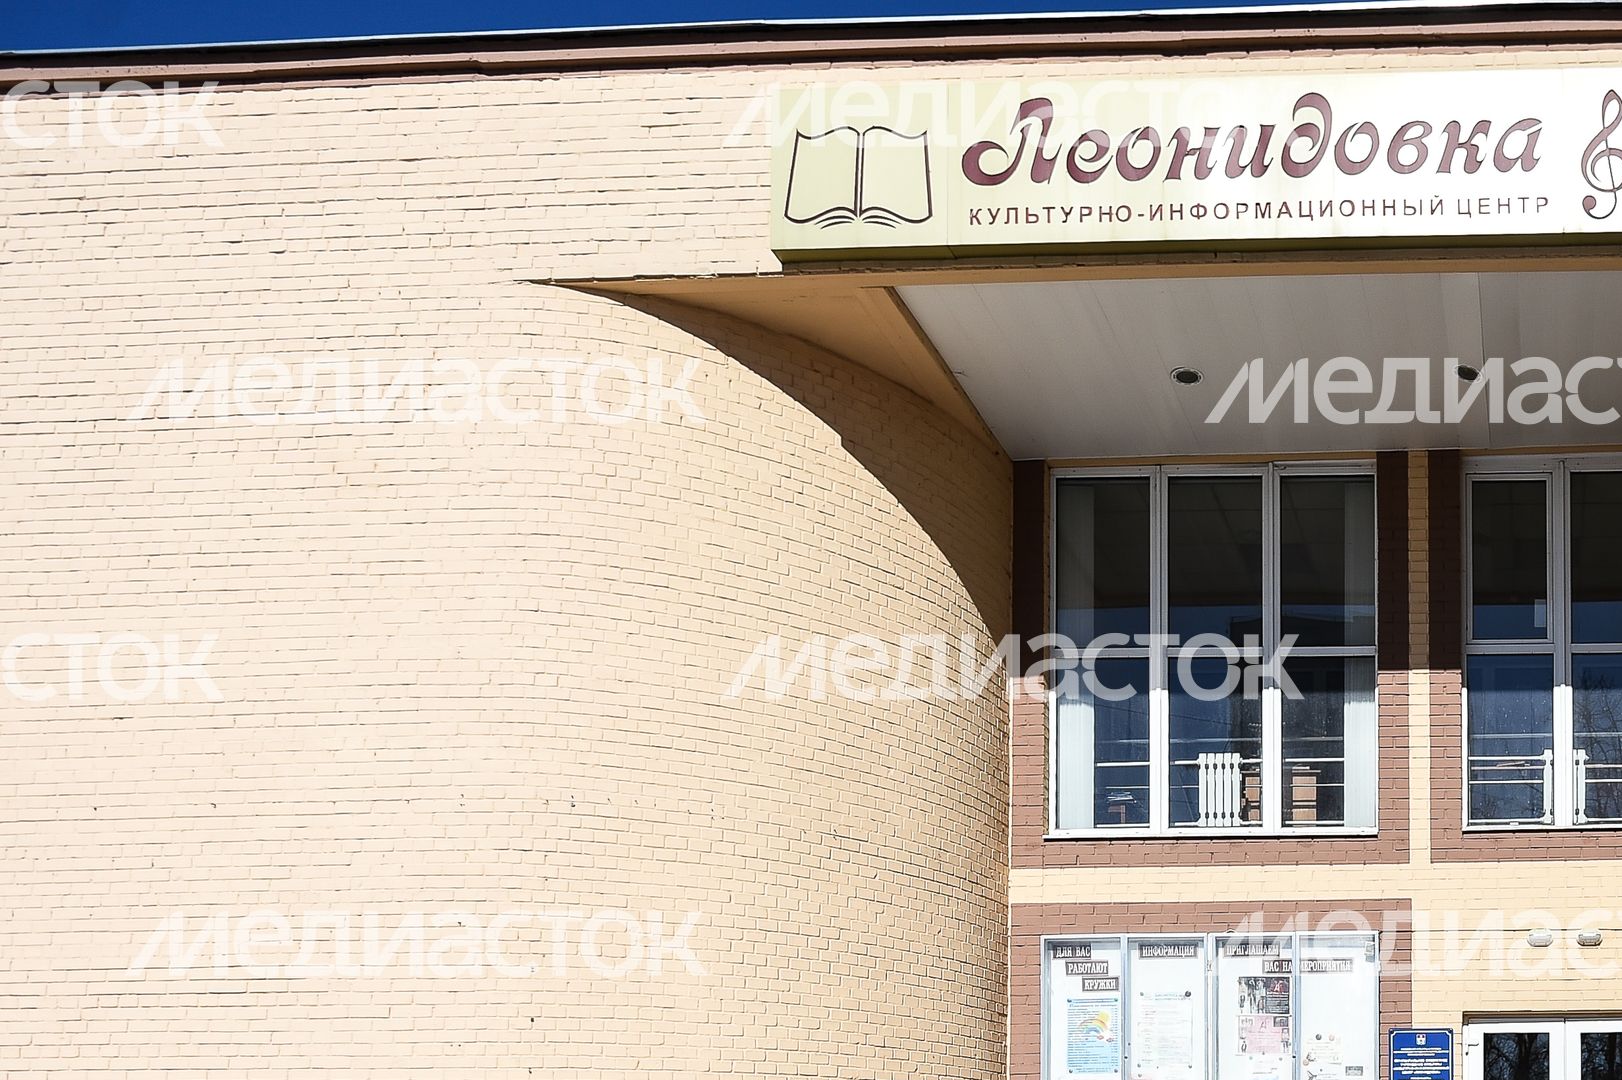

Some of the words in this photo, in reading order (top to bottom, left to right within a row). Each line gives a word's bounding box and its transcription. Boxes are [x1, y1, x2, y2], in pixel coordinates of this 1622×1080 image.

[961, 92, 1543, 186] Леонидовка
[969, 195, 1444, 226] КУЛЬТУРНО-ИНФОРМАЦИОННЫЙ
[1457, 196, 1549, 218] ЦЕНТР
[1056, 946, 1073, 958] ДЛЯ
[1076, 946, 1091, 957] ВАС
[1142, 945, 1195, 957] ИНФОРМАЦИЯ
[1226, 944, 1279, 956] ПРИГЛАШАЕМ
[1068, 962, 1108, 974] РАБОТАЮТ
[1264, 961, 1279, 973] ВАС
[1084, 979, 1116, 990] КРУЖКИ
